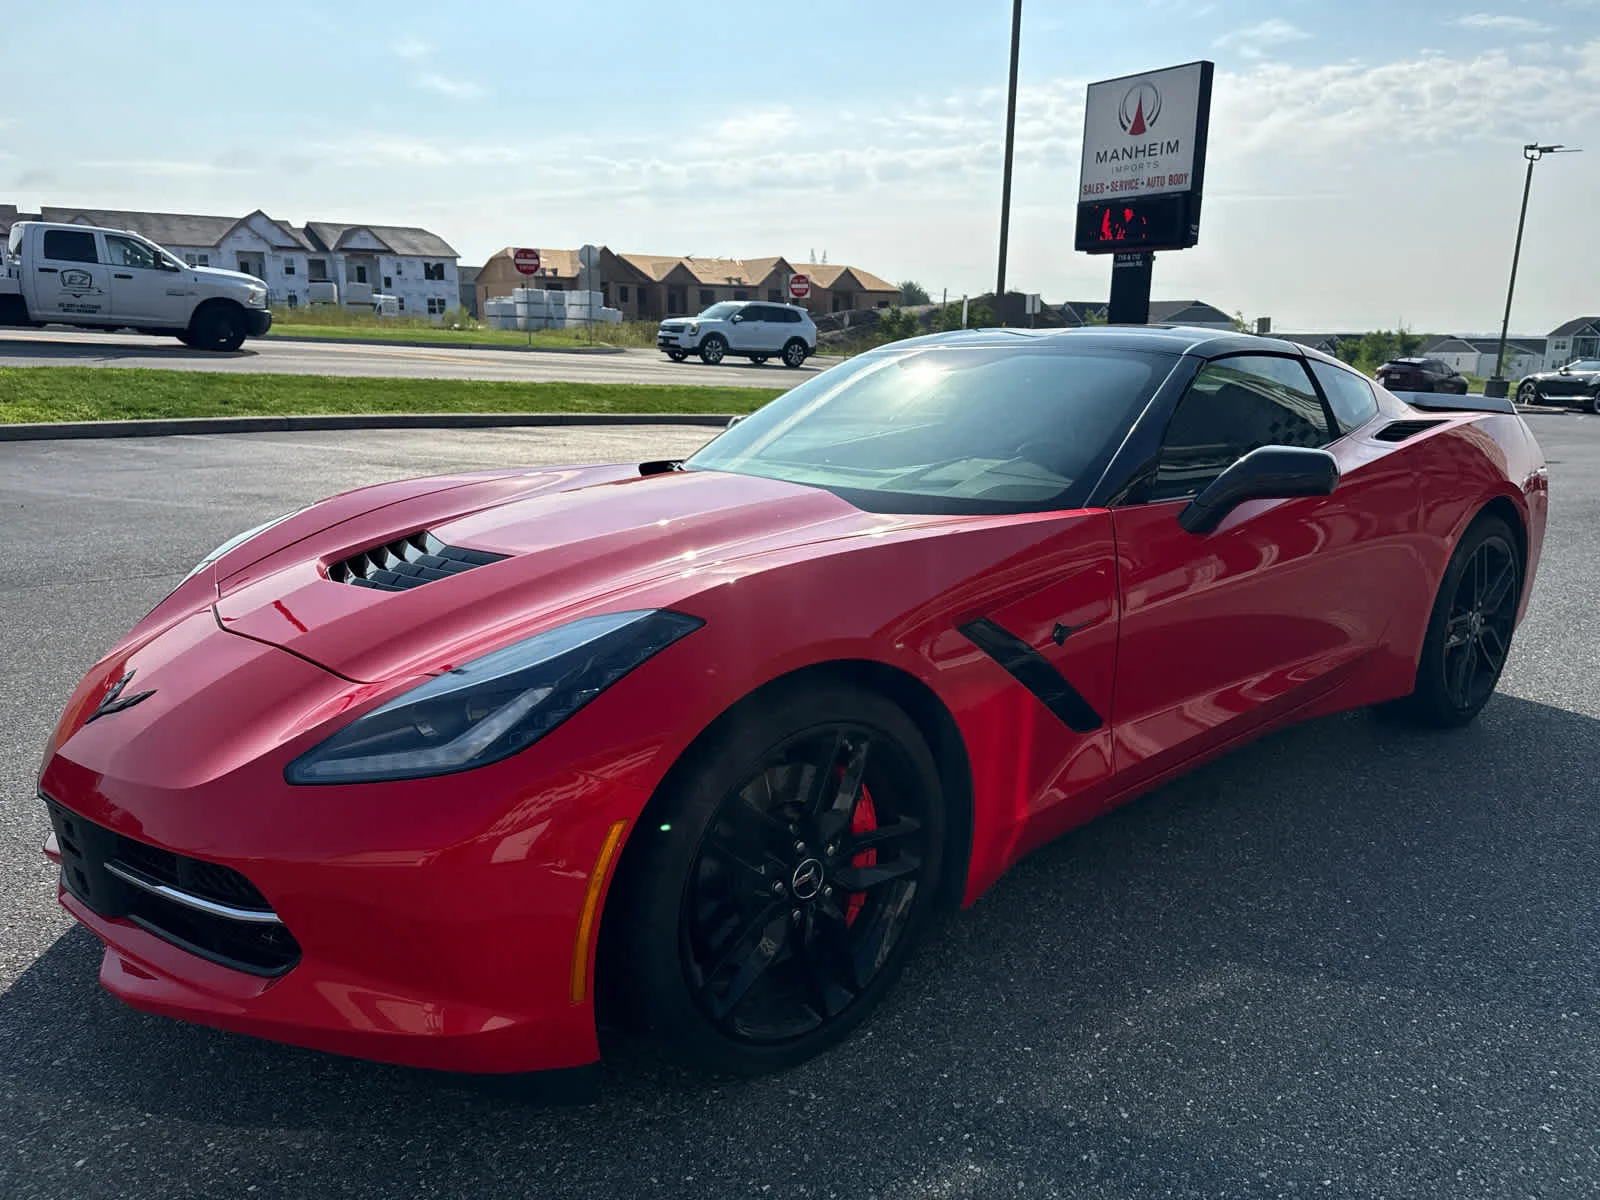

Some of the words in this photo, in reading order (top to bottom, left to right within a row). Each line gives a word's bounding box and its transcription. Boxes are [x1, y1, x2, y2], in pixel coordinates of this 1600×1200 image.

[1095, 139, 1180, 164] MANHEIM
[1112, 160, 1160, 174] IMPORTS
[1083, 182, 1105, 195] SALES
[1110, 178, 1140, 192] SERVICE
[1146, 175, 1165, 188] AUTO
[1168, 173, 1189, 186] BODY
[67, 274, 89, 286] EZ
